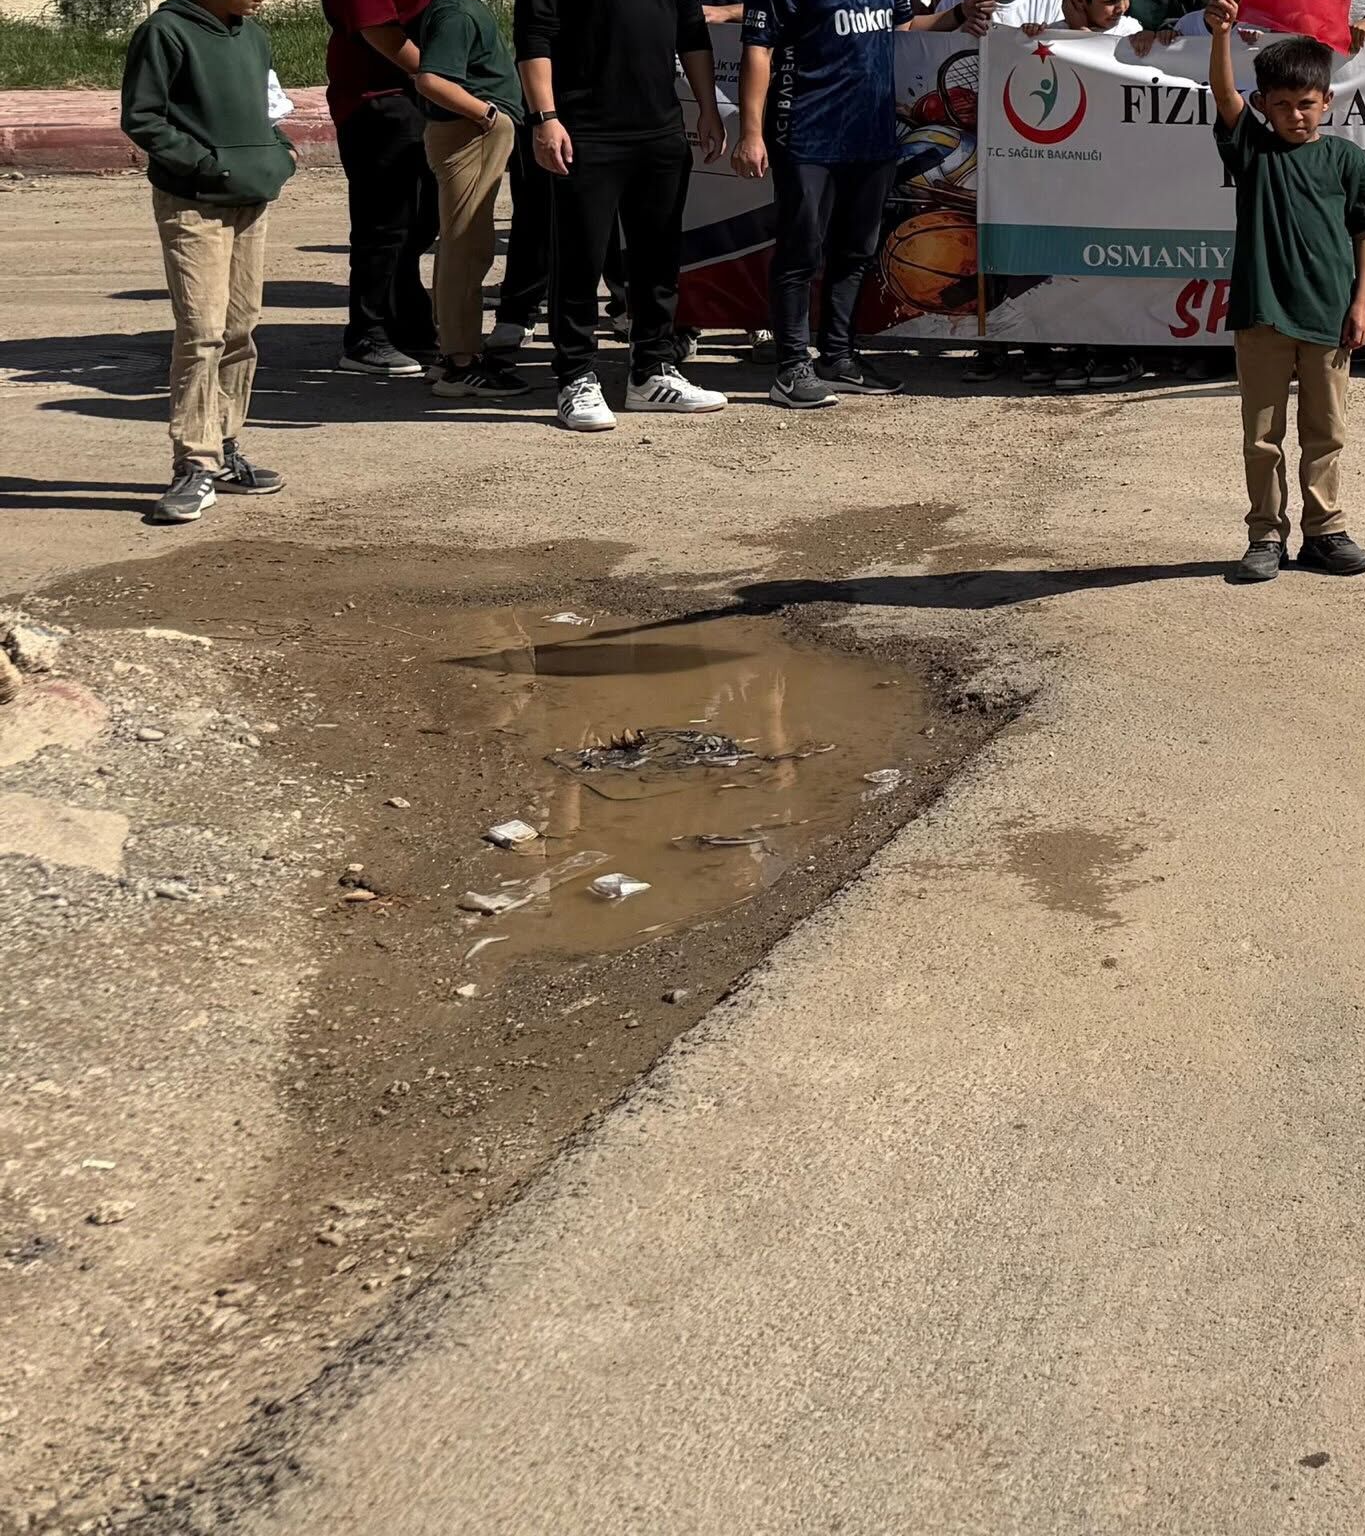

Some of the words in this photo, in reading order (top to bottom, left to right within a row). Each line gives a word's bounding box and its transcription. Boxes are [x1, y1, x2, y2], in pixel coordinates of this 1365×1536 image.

[835, 6, 893, 36] Otokoç
[775, 45, 796, 146] ACIBADEM
[987, 146, 1006, 158] T.C.
[1008, 146, 1045, 160] SAĞLIK
[1047, 148, 1102, 161] BAKANLIĞI
[1083, 240, 1231, 270] OSMANİY
